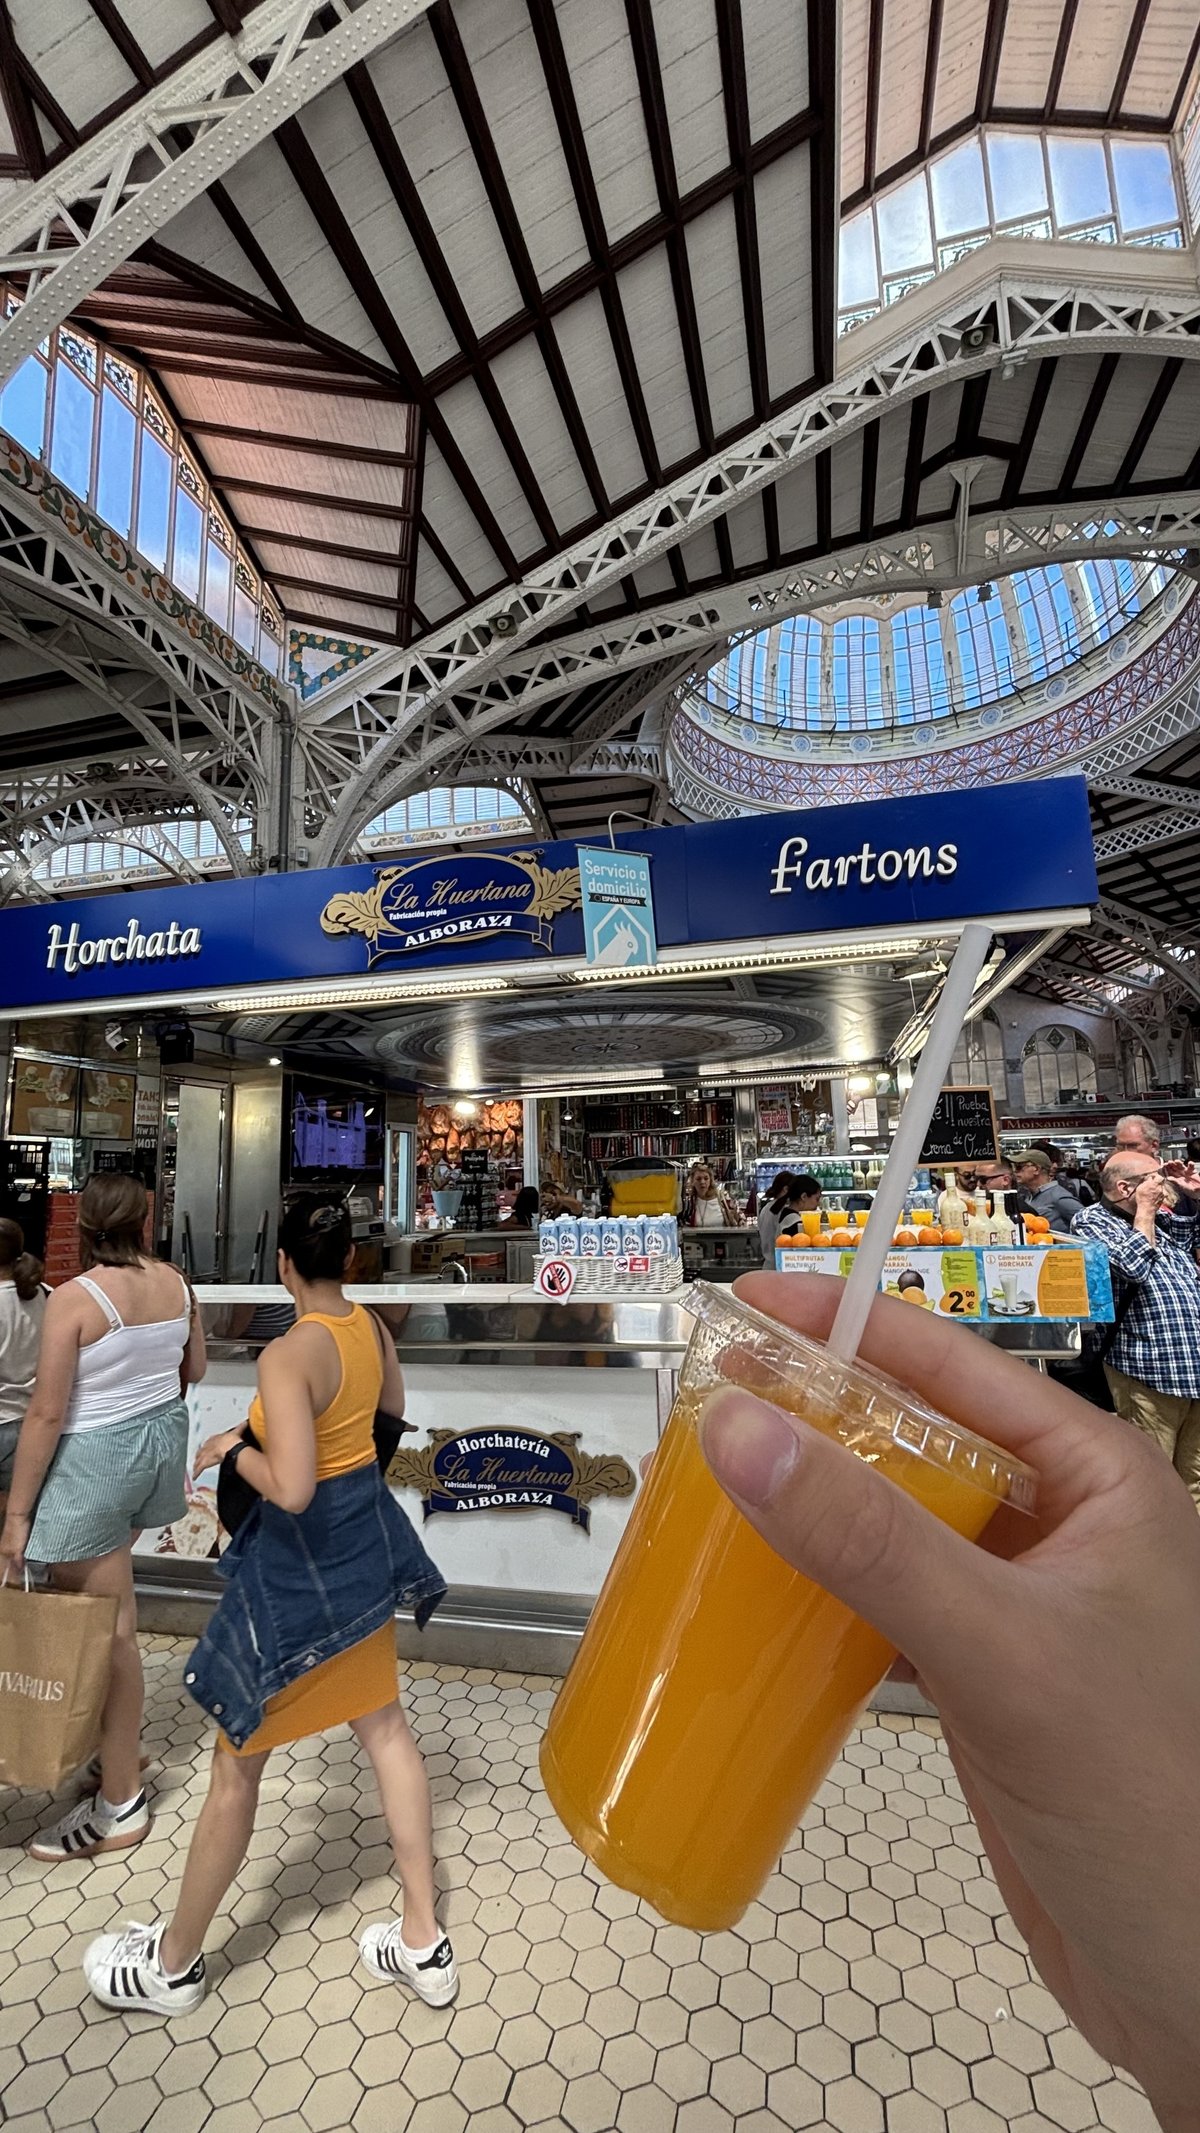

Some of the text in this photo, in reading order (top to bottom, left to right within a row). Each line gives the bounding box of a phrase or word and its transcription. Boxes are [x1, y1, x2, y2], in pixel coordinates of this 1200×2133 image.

[584, 859, 647, 881] Servicio a
[769, 836, 958, 895] fartons
[382, 878, 532, 912] La Huertana
[588, 877, 647, 898] domicilio
[601, 895, 620, 903] ESPAÑA
[623, 897, 641, 905] EUROPA
[389, 908, 447, 921] Fabricación propia
[404, 915, 513, 948] ALBORAYA
[46, 918, 202, 973] Horchata
[956, 1093, 990, 1112] Prueba
[957, 1111, 991, 1127] nuestra
[967, 1301, 975, 1310] €
[456, 1433, 550, 1458] Horchatería
[438, 1454, 573, 1485] La Huertana
[444, 1480, 497, 1491] Fabricación propia
[456, 1492, 553, 1511] ALBORAYA
